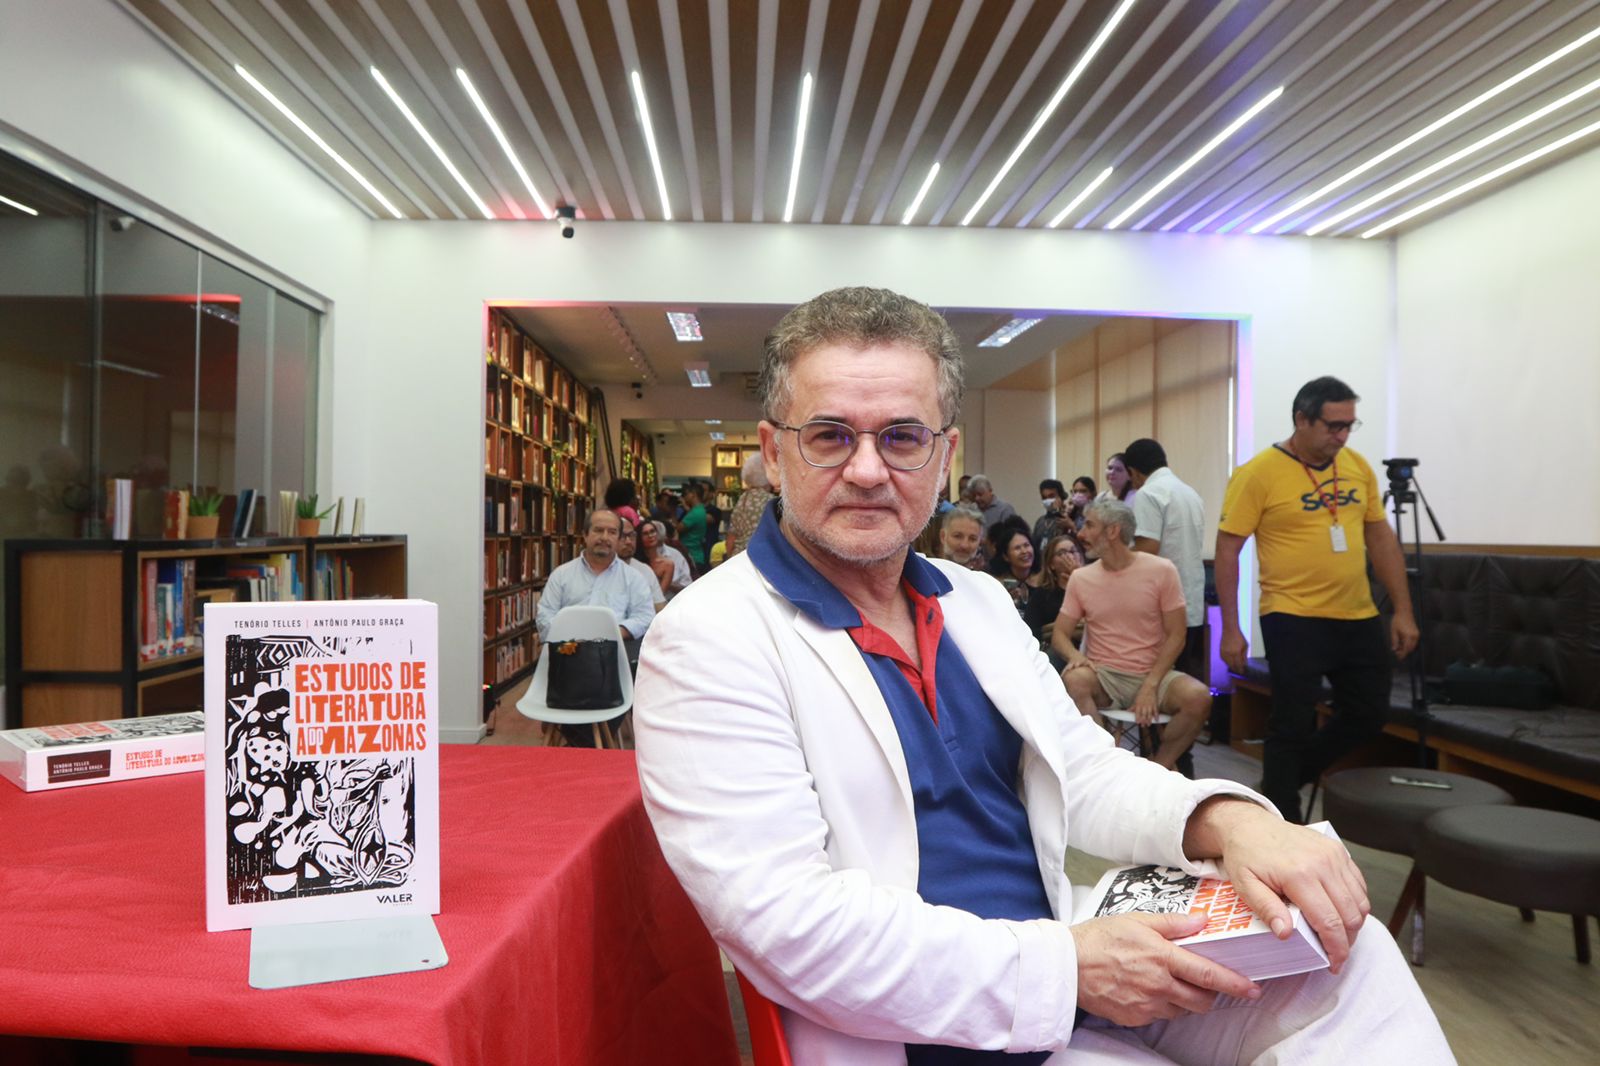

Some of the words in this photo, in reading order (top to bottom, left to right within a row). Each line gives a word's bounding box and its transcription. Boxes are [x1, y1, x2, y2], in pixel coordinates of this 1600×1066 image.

[234, 620, 269, 629] TENÓRIO
[273, 619, 302, 628] TELLES
[313, 618, 348, 627] ANTÔNIO
[351, 618, 376, 627] PAULO
[379, 617, 405, 627] GRAÇA
[295, 662, 393, 693] ESTUDOS
[400, 661, 427, 690] DE
[295, 692, 427, 724] LITERATURA
[376, 893, 413, 904] VALER
